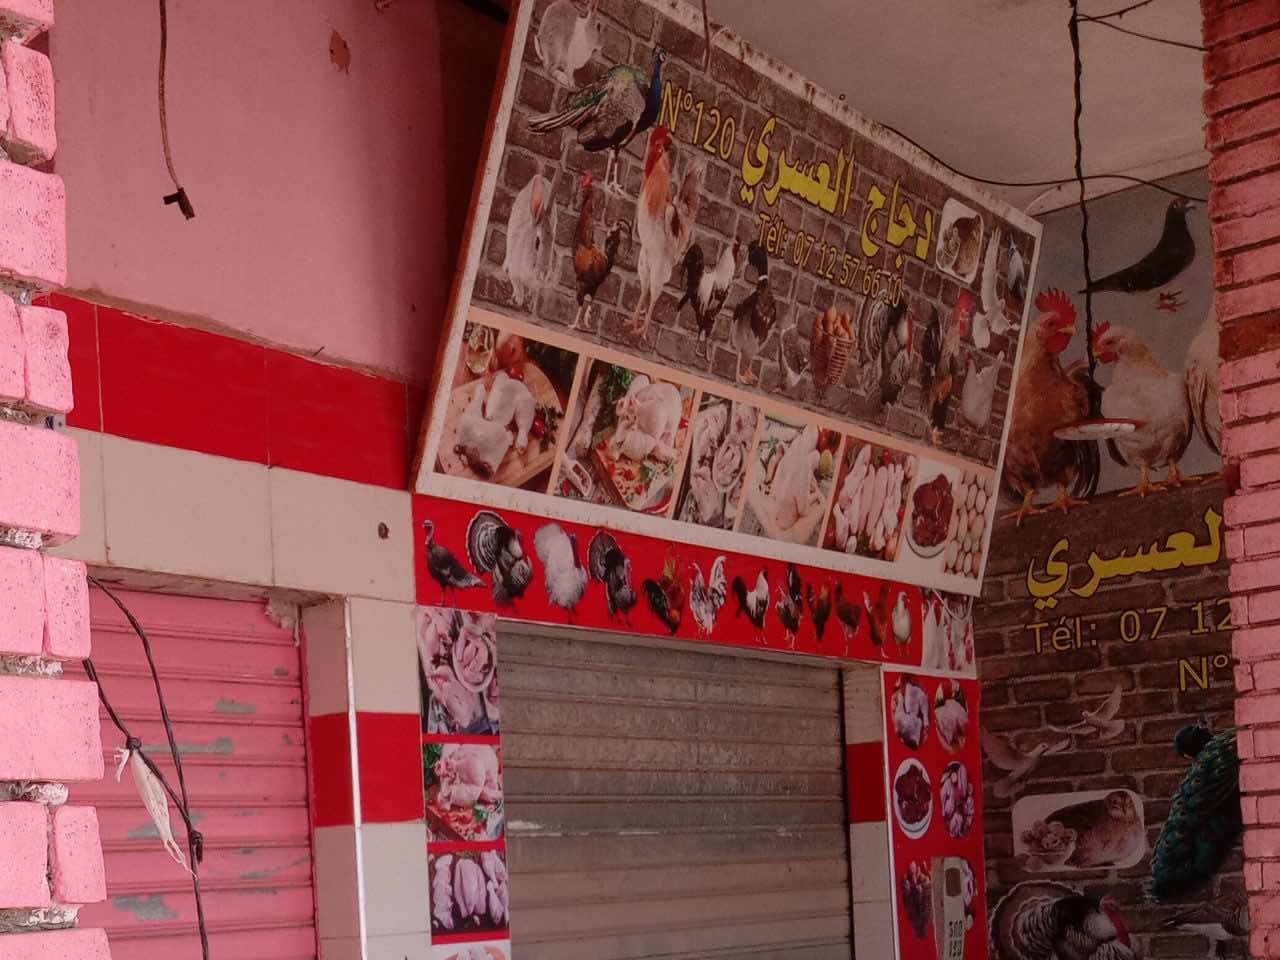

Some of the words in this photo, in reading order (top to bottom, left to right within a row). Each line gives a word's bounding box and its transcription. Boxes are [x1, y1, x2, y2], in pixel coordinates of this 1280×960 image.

[740, 116, 855, 216] العسري
[758, 211, 788, 257] Tél:
[793, 231, 816, 267] 07
[817, 244, 838, 280] 12
[840, 254, 861, 288] 57
[861, 178, 934, 268] دجاج
[1027, 507, 1222, 611] لعسري
[1026, 616, 1098, 655] Tél:
[1119, 606, 1170, 643] 07
[1190, 597, 1232, 635] 12
[1177, 655, 1229, 692] N°
